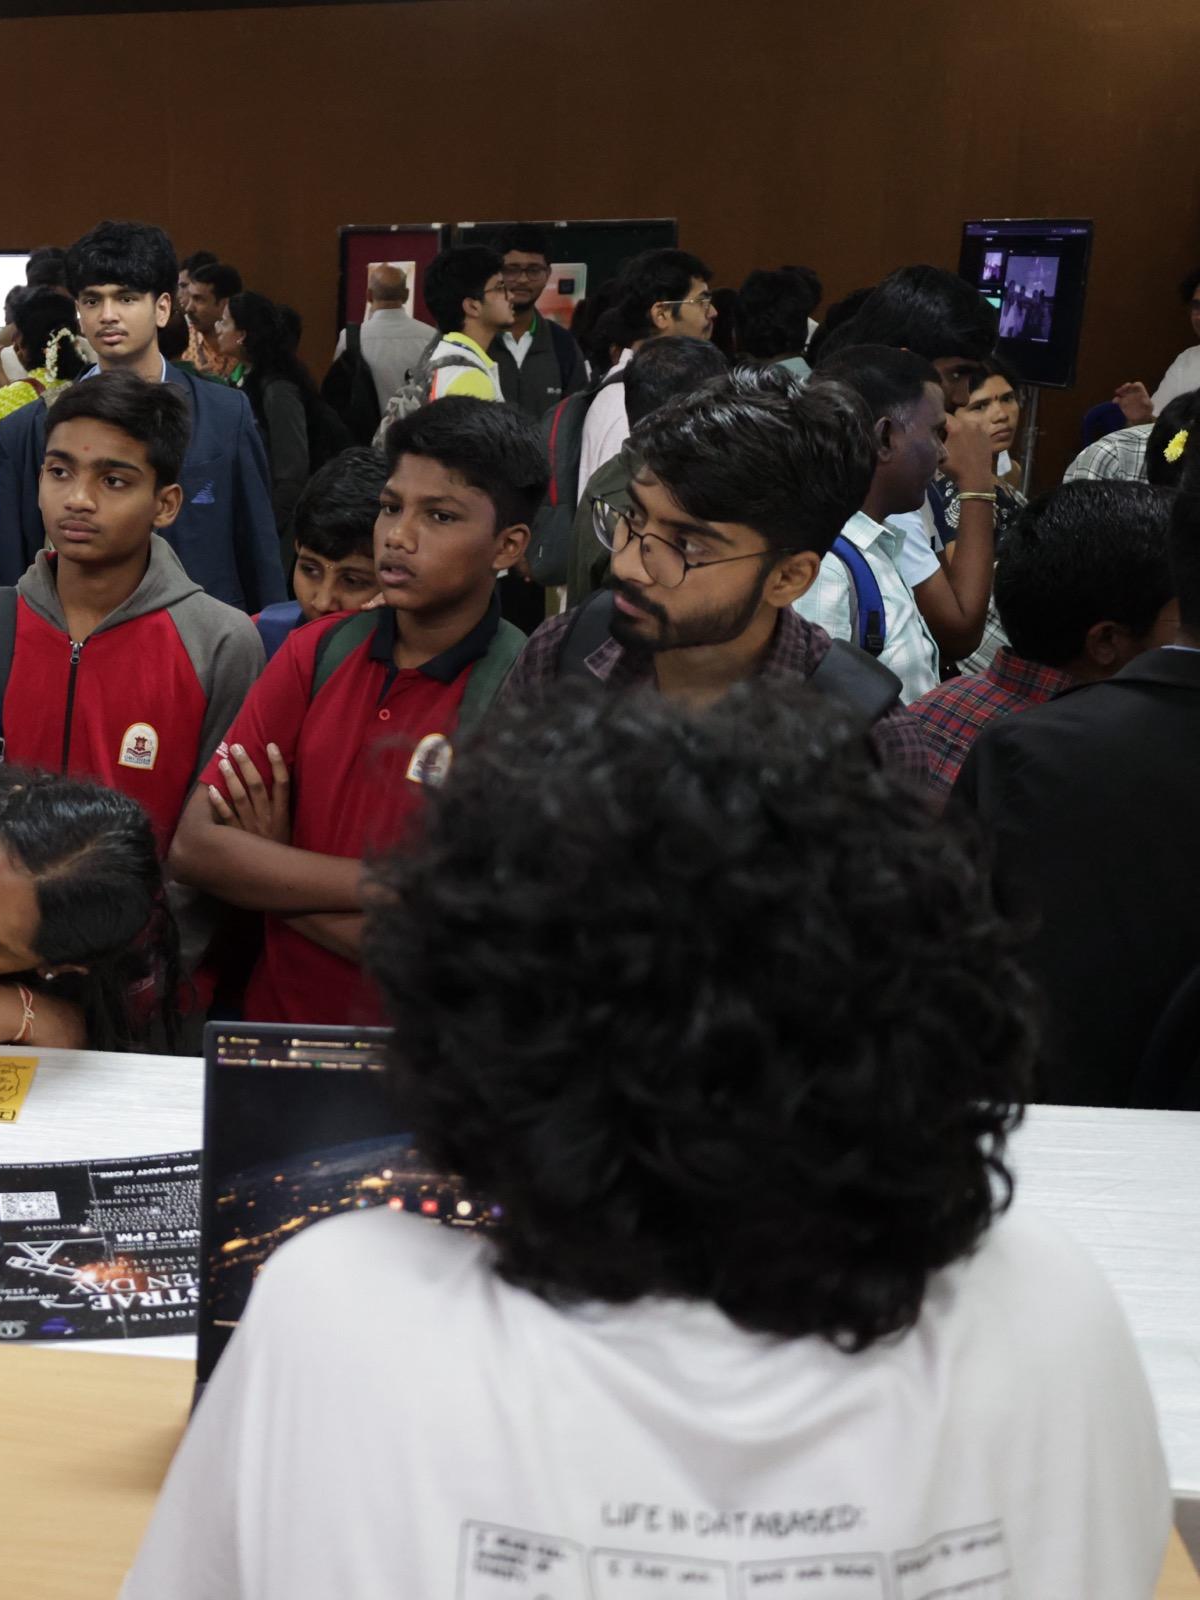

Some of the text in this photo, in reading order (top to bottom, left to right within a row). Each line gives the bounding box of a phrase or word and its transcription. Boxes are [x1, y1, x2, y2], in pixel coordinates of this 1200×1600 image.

[136, 1167, 171, 1176] MANY
[173, 1164, 199, 1172] AND
[114, 1185, 201, 1195] PECTROMETER
[86, 1213, 200, 1223] TROPHOTOGRAPHY
[116, 1232, 144, 1243] PM
[146, 1231, 157, 1241] 5
[96, 1255, 197, 1268] BANGALORE
[155, 1262, 199, 1273] ARCH
[68, 1272, 200, 1295] EN DAY
[4, 1293, 60, 1302] Astronomy
[88, 1287, 200, 1310] STRAE
[105, 1309, 196, 1324] JOIN US AT
[601, 1503, 663, 1533] LIFE
